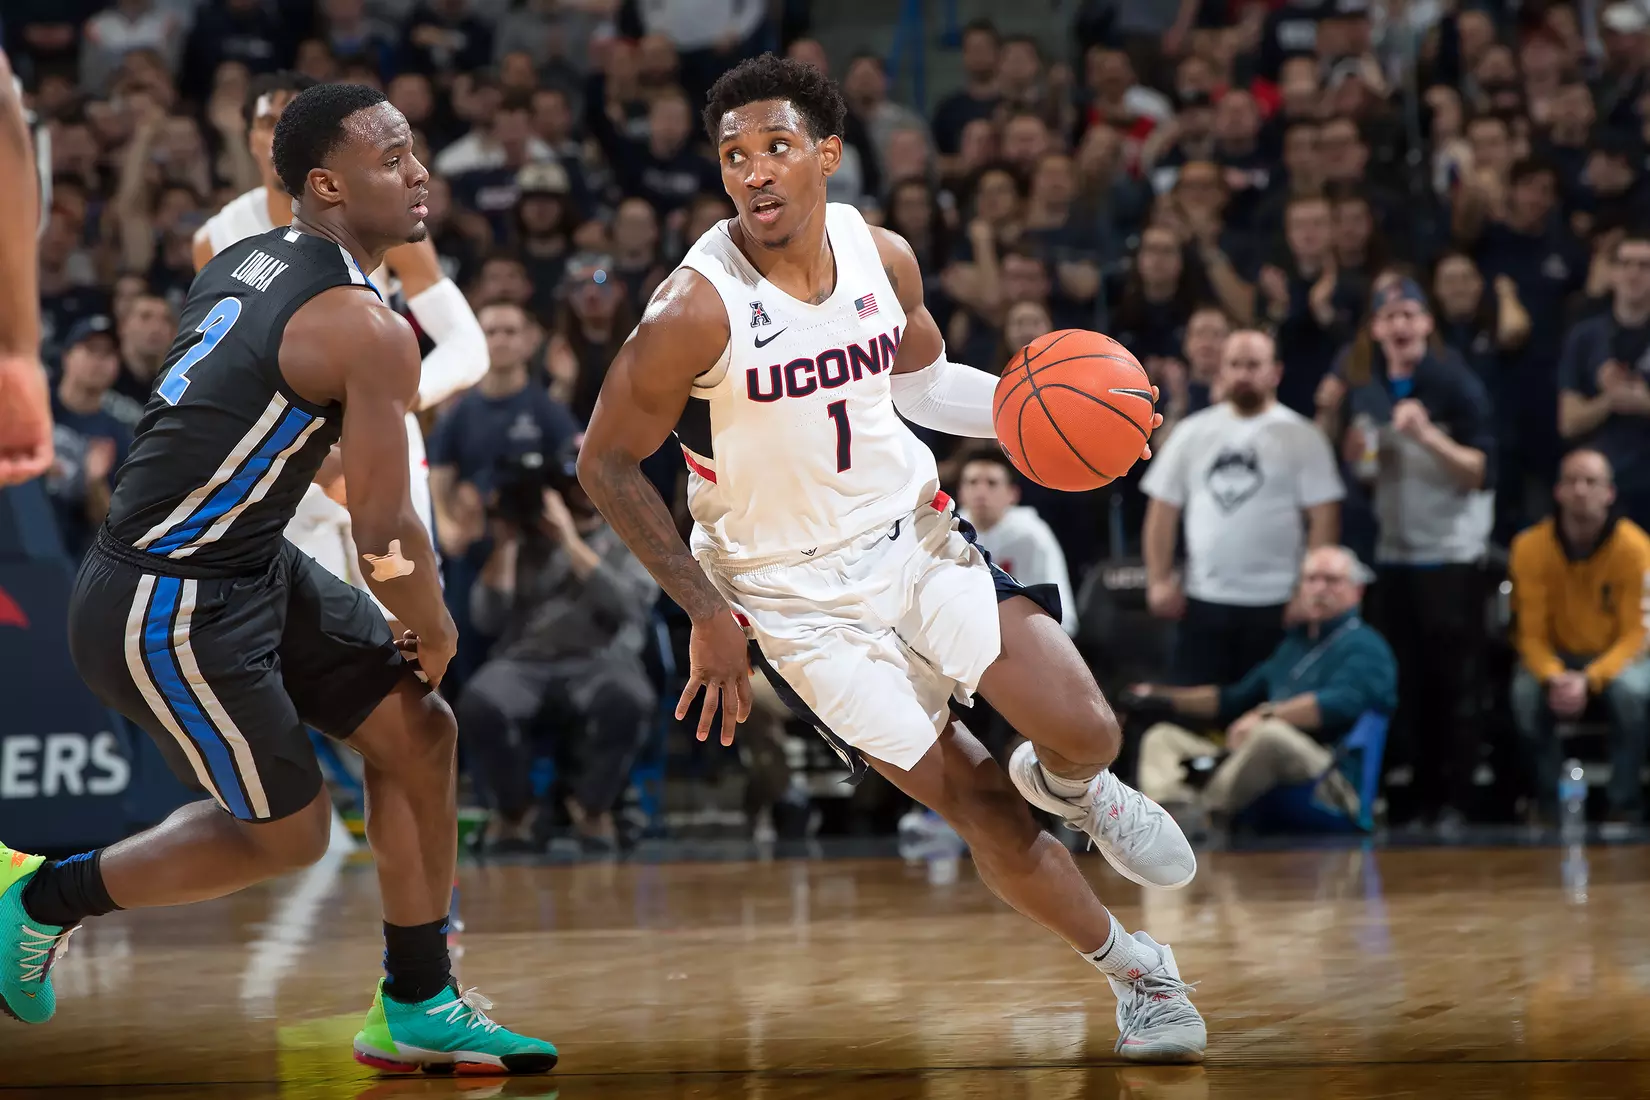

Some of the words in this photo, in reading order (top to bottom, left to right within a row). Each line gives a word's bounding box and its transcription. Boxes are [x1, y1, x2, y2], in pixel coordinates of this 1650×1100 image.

[231, 249, 289, 293] LOMAX
[157, 296, 242, 406] 2
[746, 325, 901, 403] UCONN
[827, 399, 852, 473] 1
[1, 732, 131, 798] ERS
